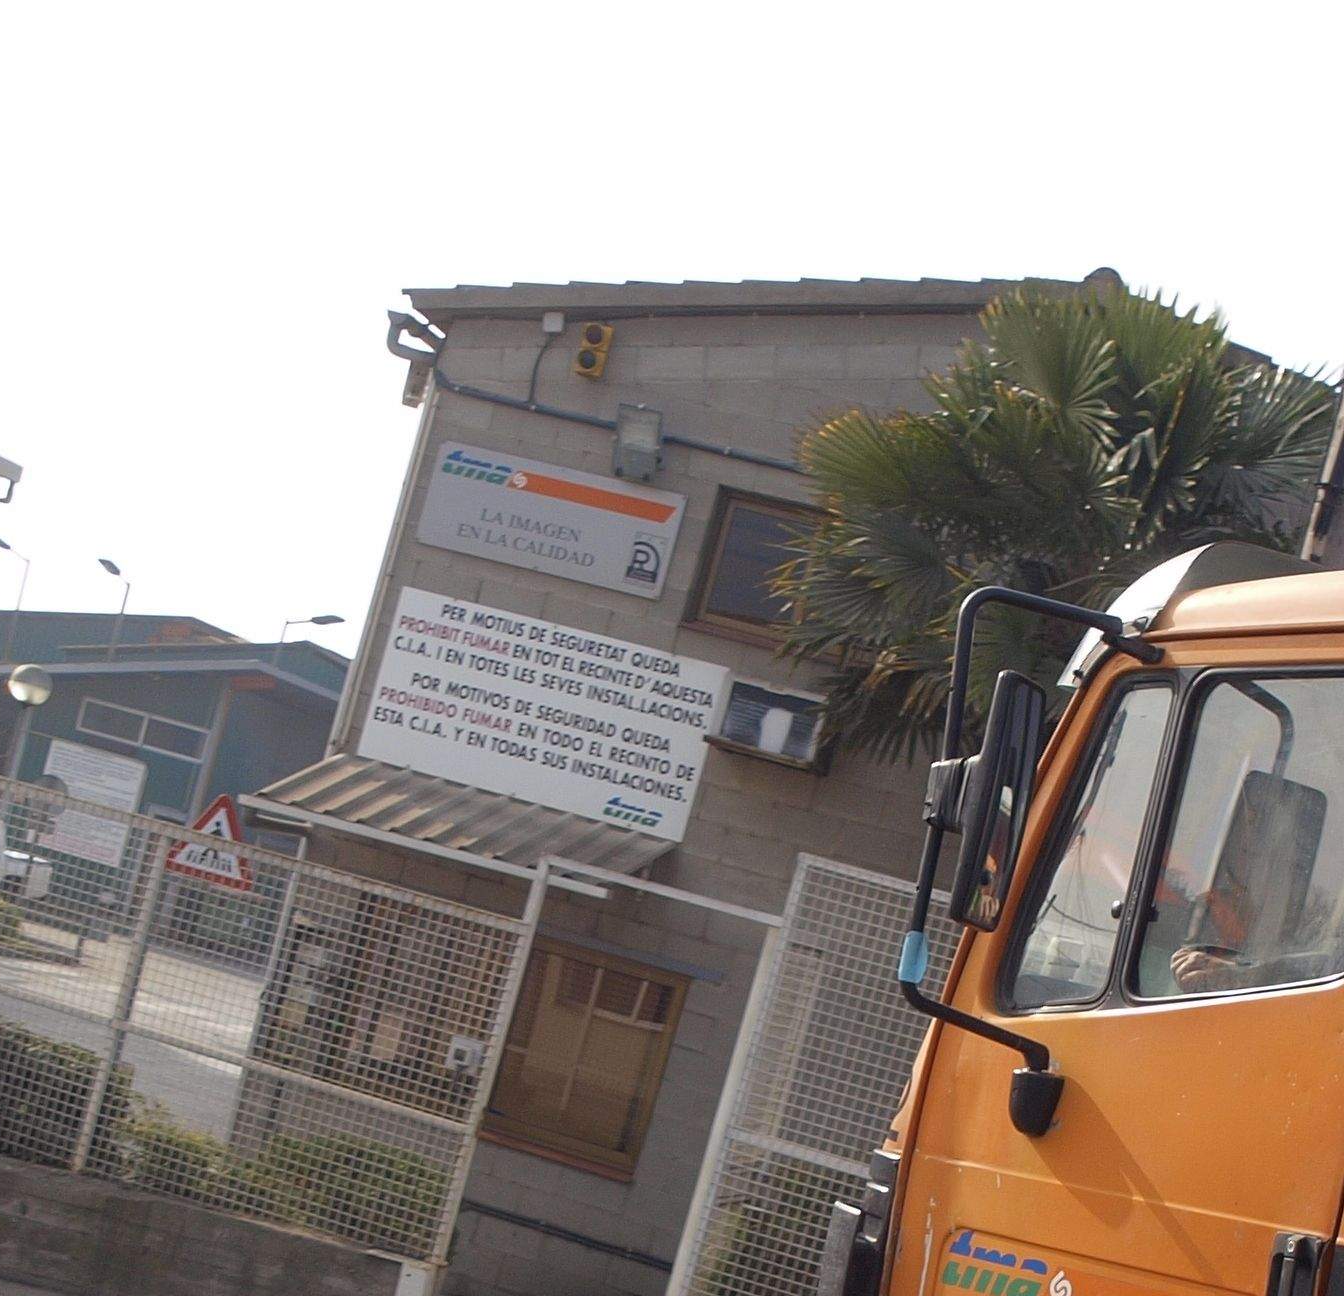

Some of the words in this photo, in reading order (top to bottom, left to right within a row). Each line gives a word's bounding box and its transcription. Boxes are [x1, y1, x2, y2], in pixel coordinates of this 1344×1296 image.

[456, 523, 482, 539] EN
[484, 529, 508, 547] LA
[513, 536, 595, 567] CALIDAD
[480, 508, 503, 526] LA
[508, 514, 582, 543] IMAGEN
[394, 636, 431, 657] C.I.A.
[435, 646, 443, 660] I
[445, 649, 466, 666] EN
[469, 654, 509, 677] TOTES
[513, 666, 537, 684] LES
[540, 673, 583, 696] SEVES
[399, 615, 461, 643] PROHIBIT
[462, 631, 510, 656] FUMAR
[512, 644, 531, 661] EN
[535, 649, 560, 668] TOT
[561, 657, 574, 672] EL
[577, 661, 633, 688] RECINTE
[440, 604, 467, 622] PER
[471, 611, 526, 637] MOTIUS
[529, 626, 547, 642] DE
[549, 632, 628, 662] SEGURETAT
[631, 652, 680, 677] QUEDA
[379, 686, 458, 718] PROHIBIDO
[462, 708, 512, 733] FUMAR
[517, 722, 538, 739] EN
[543, 729, 584, 751] TODO
[589, 741, 603, 757] EL
[608, 747, 671, 774] RECINTO
[676, 764, 696, 781] DE
[411, 672, 441, 692] POR
[445, 681, 510, 710] MOTIVOS
[514, 699, 533, 716] DE
[536, 705, 616, 737] SEGURIDAD
[621, 728, 671, 753] QUEDA
[373, 706, 404, 727] ESTA
[409, 716, 447, 738] C.I.A.
[453, 727, 464, 742] Y
[467, 731, 488, 748] EN
[491, 737, 538, 762] TODAS
[540, 751, 569, 770] SUS
[571, 759, 687, 803] INSTALACIONES.
